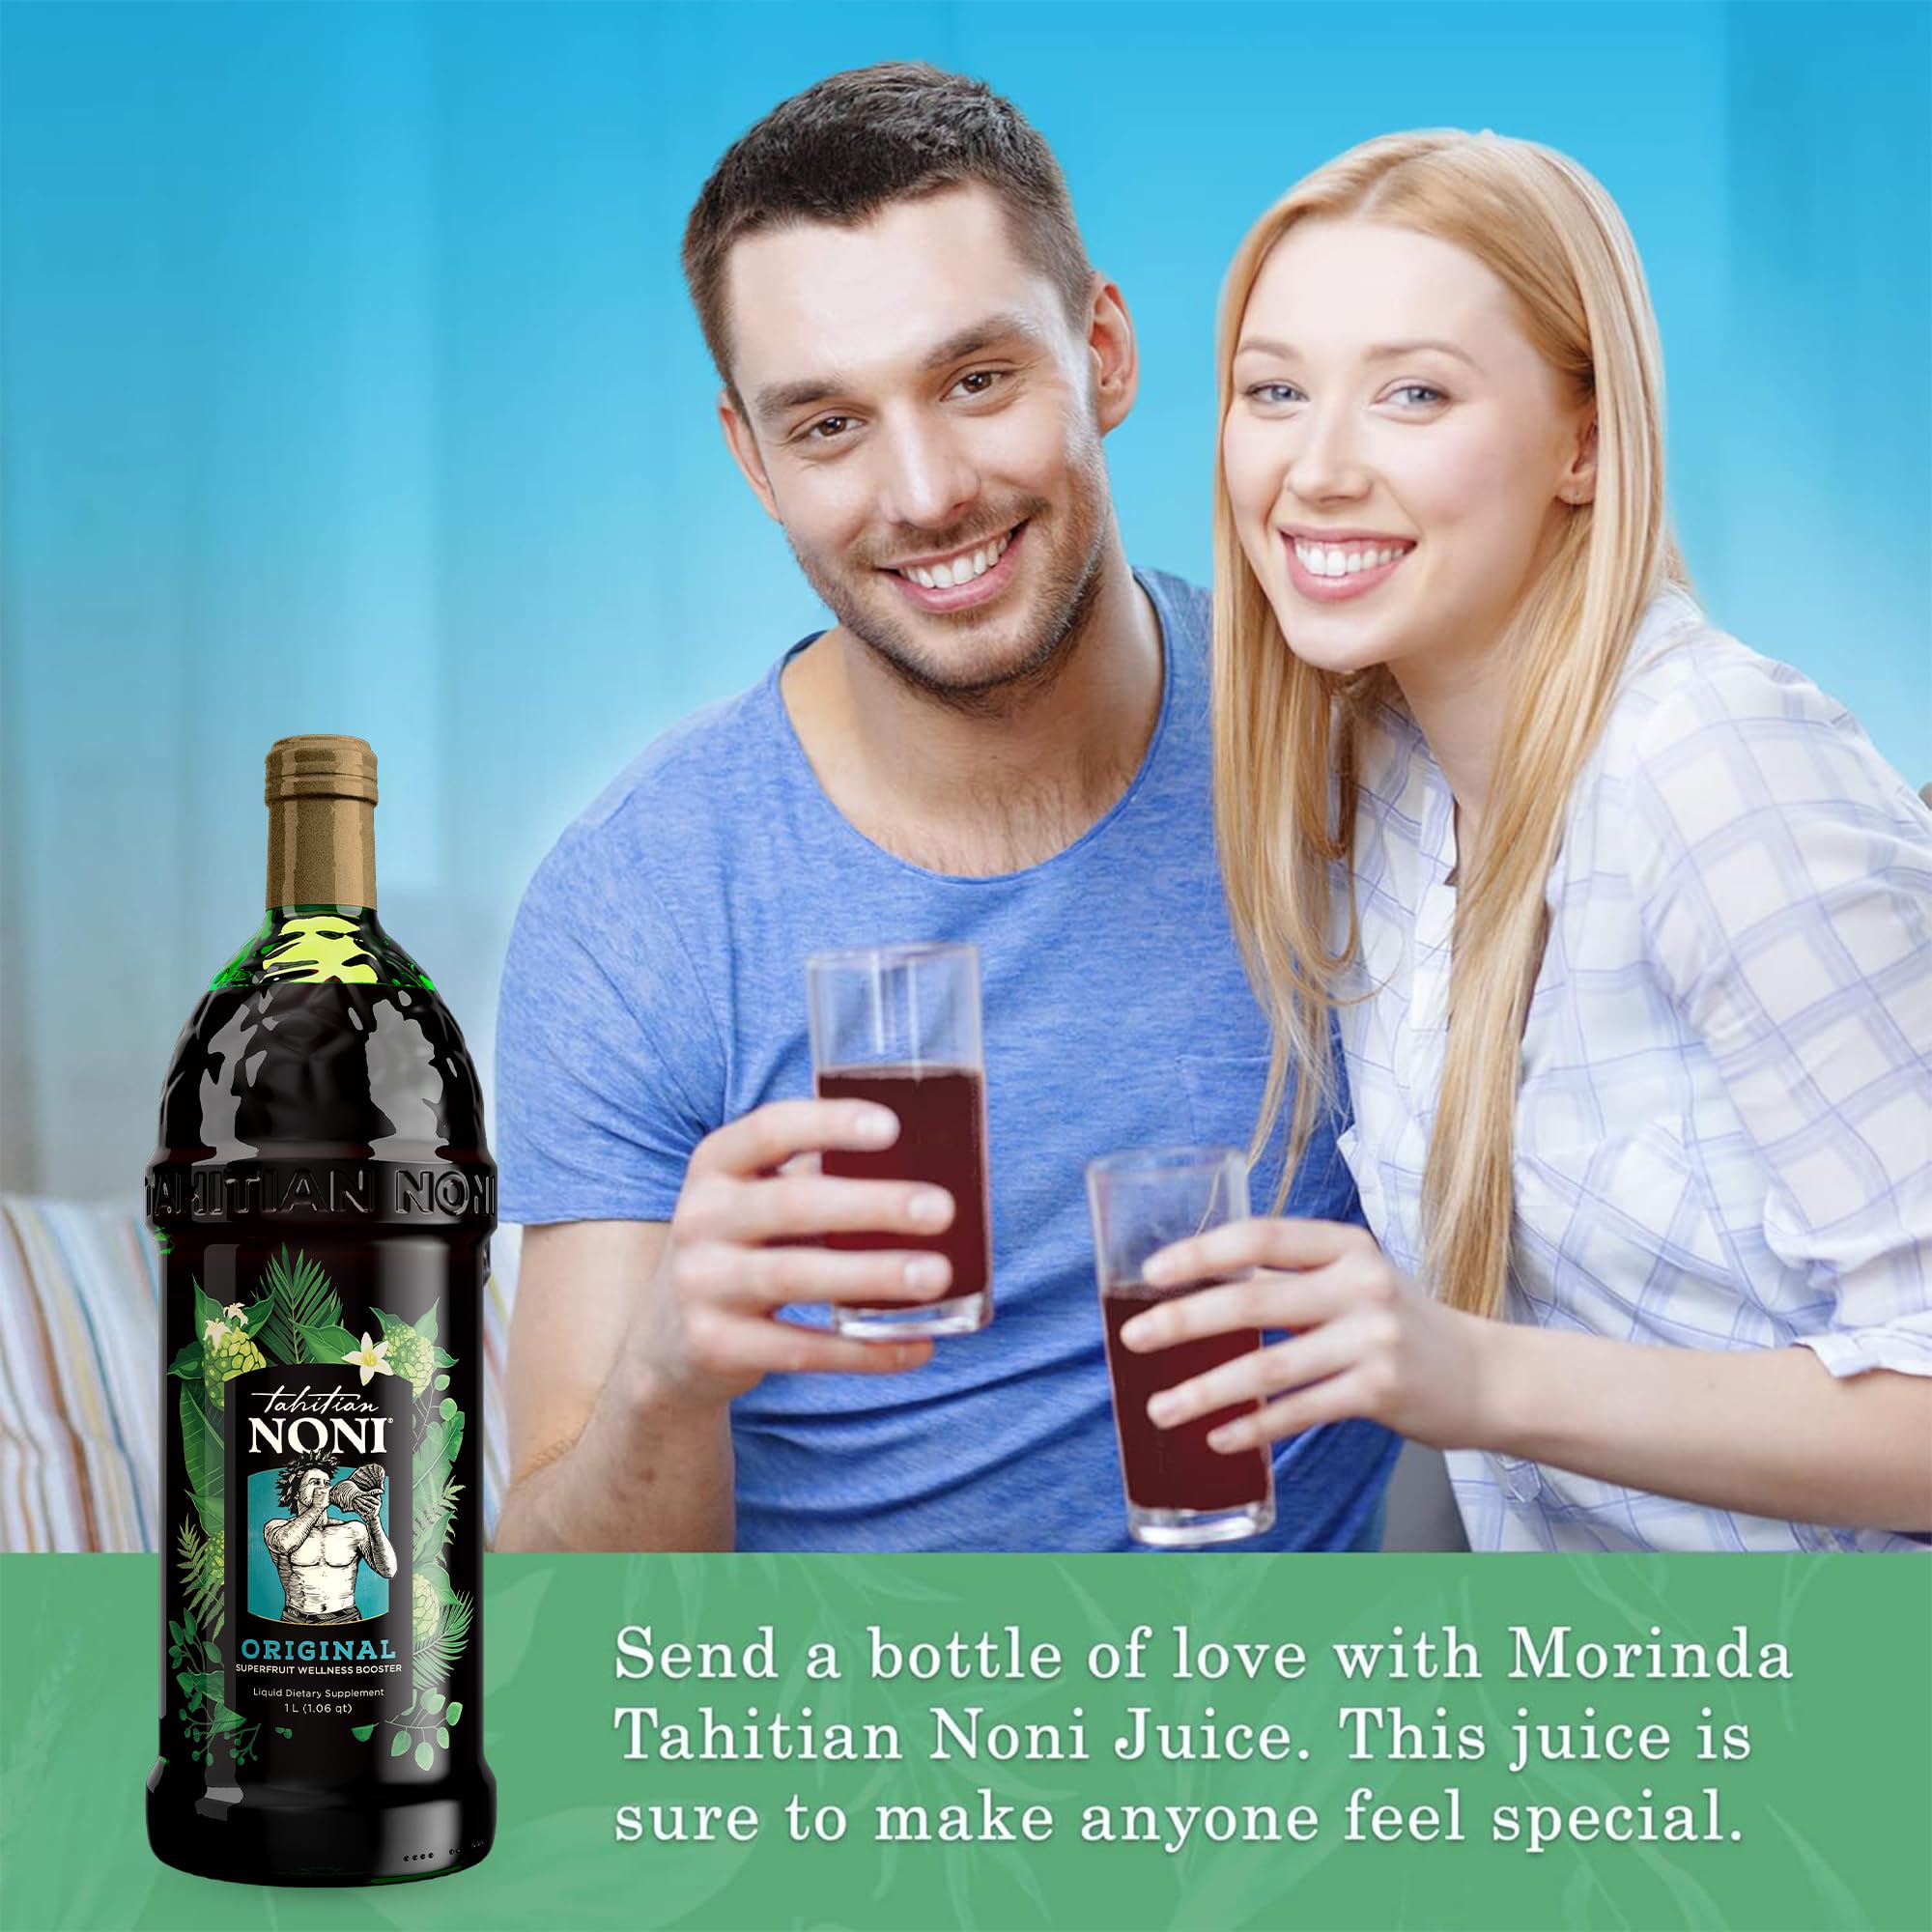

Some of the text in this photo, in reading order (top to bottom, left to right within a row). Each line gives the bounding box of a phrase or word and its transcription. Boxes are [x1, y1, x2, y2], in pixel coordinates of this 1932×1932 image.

[394, 1168, 496, 1216] NONI
[242, 1638, 396, 1662] ORIGINAL
[235, 1663, 402, 1675] SUPERFRUIT WELLNESS BOOSTER
[253, 1688, 384, 1699] Liquid Dietary Supplement
[284, 1703, 353, 1715] 1 L (1.06 qt)
